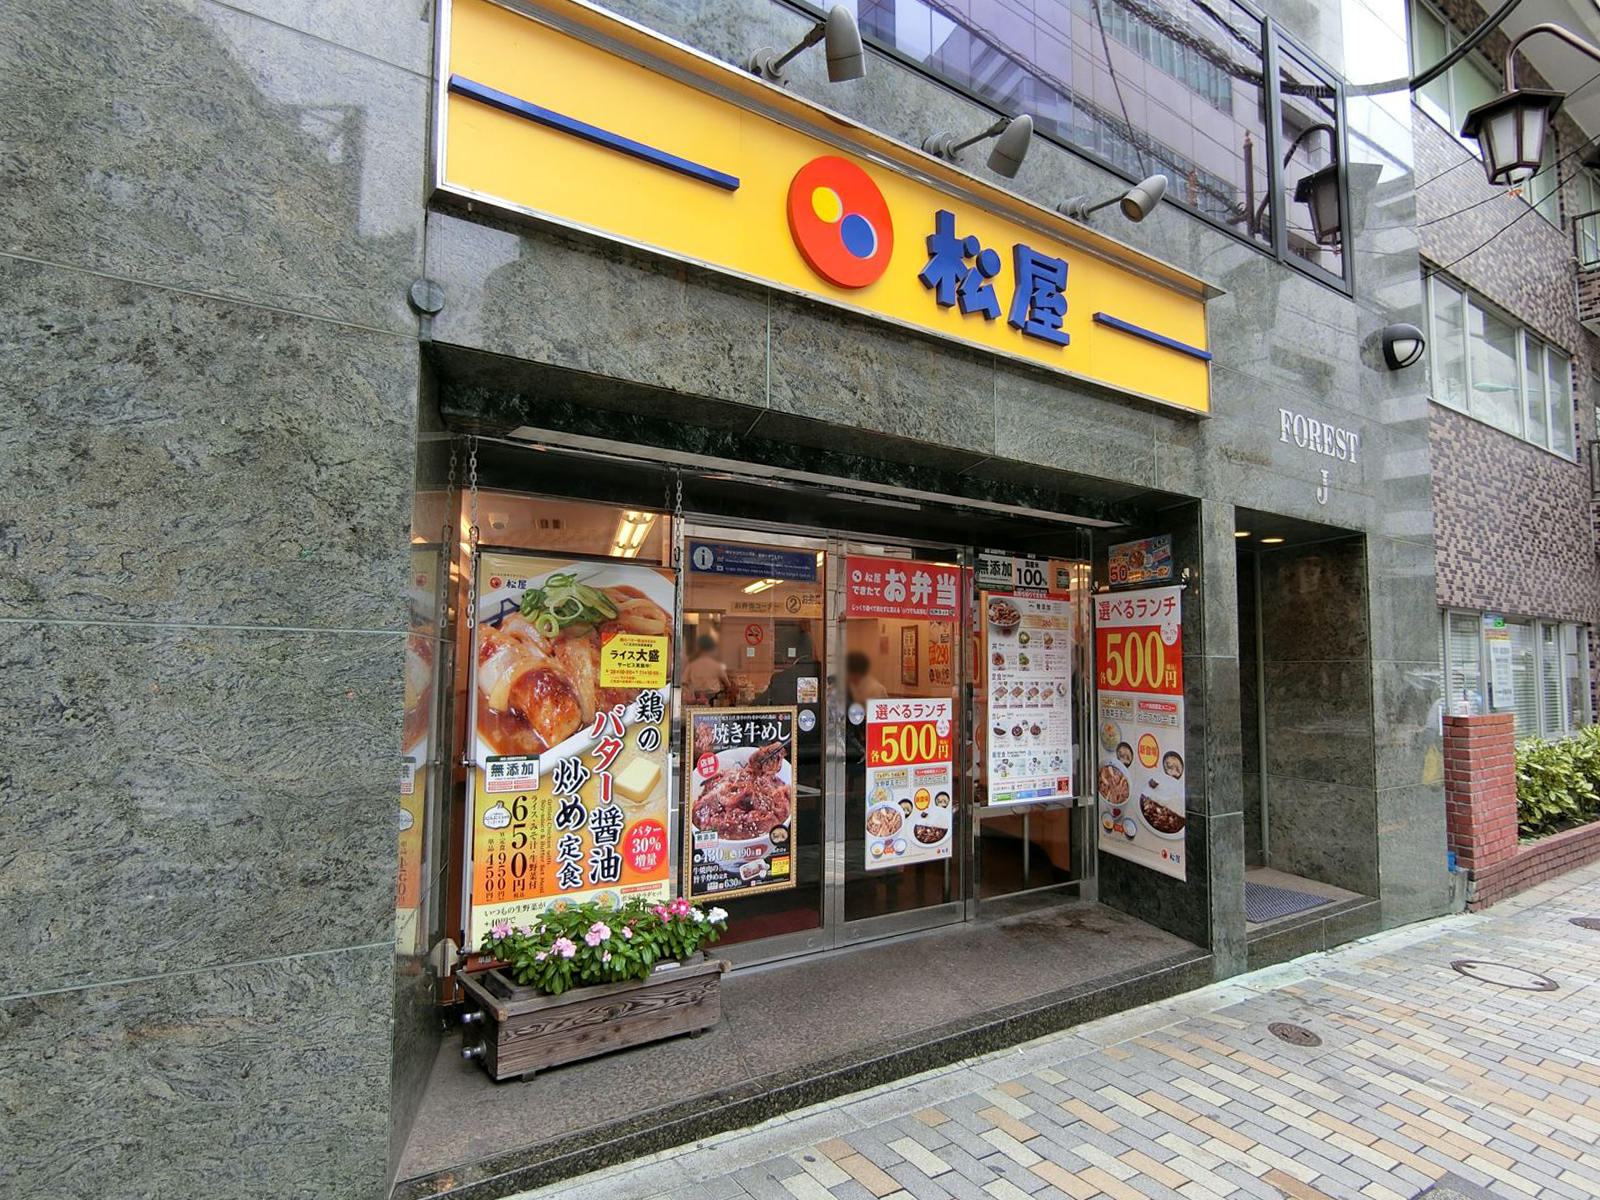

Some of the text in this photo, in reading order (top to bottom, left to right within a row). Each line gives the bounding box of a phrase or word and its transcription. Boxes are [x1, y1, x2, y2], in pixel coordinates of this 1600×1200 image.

[917, 209, 1070, 348] 松屋
[1278, 408, 1359, 464] FOREST
[1316, 468, 1329, 505] J
[979, 559, 1013, 577] 無添加
[852, 585, 881, 597] できたて
[883, 568, 956, 607] お弁当
[1098, 595, 1176, 621] 選べるランチ
[610, 648, 660, 663] ライス大盛
[635, 690, 664, 751] 鶏の
[875, 703, 947, 720] 選べるランチ
[711, 721, 791, 744] 焼き牛めし
[490, 762, 534, 777] 無添加
[589, 704, 626, 883] バター醤油
[552, 757, 590, 890] 炒め定食
[632, 825, 662, 836] バター
[510, 795, 528, 892] 650円
[632, 836, 662, 854] 30%
[634, 853, 657, 867] 増量
